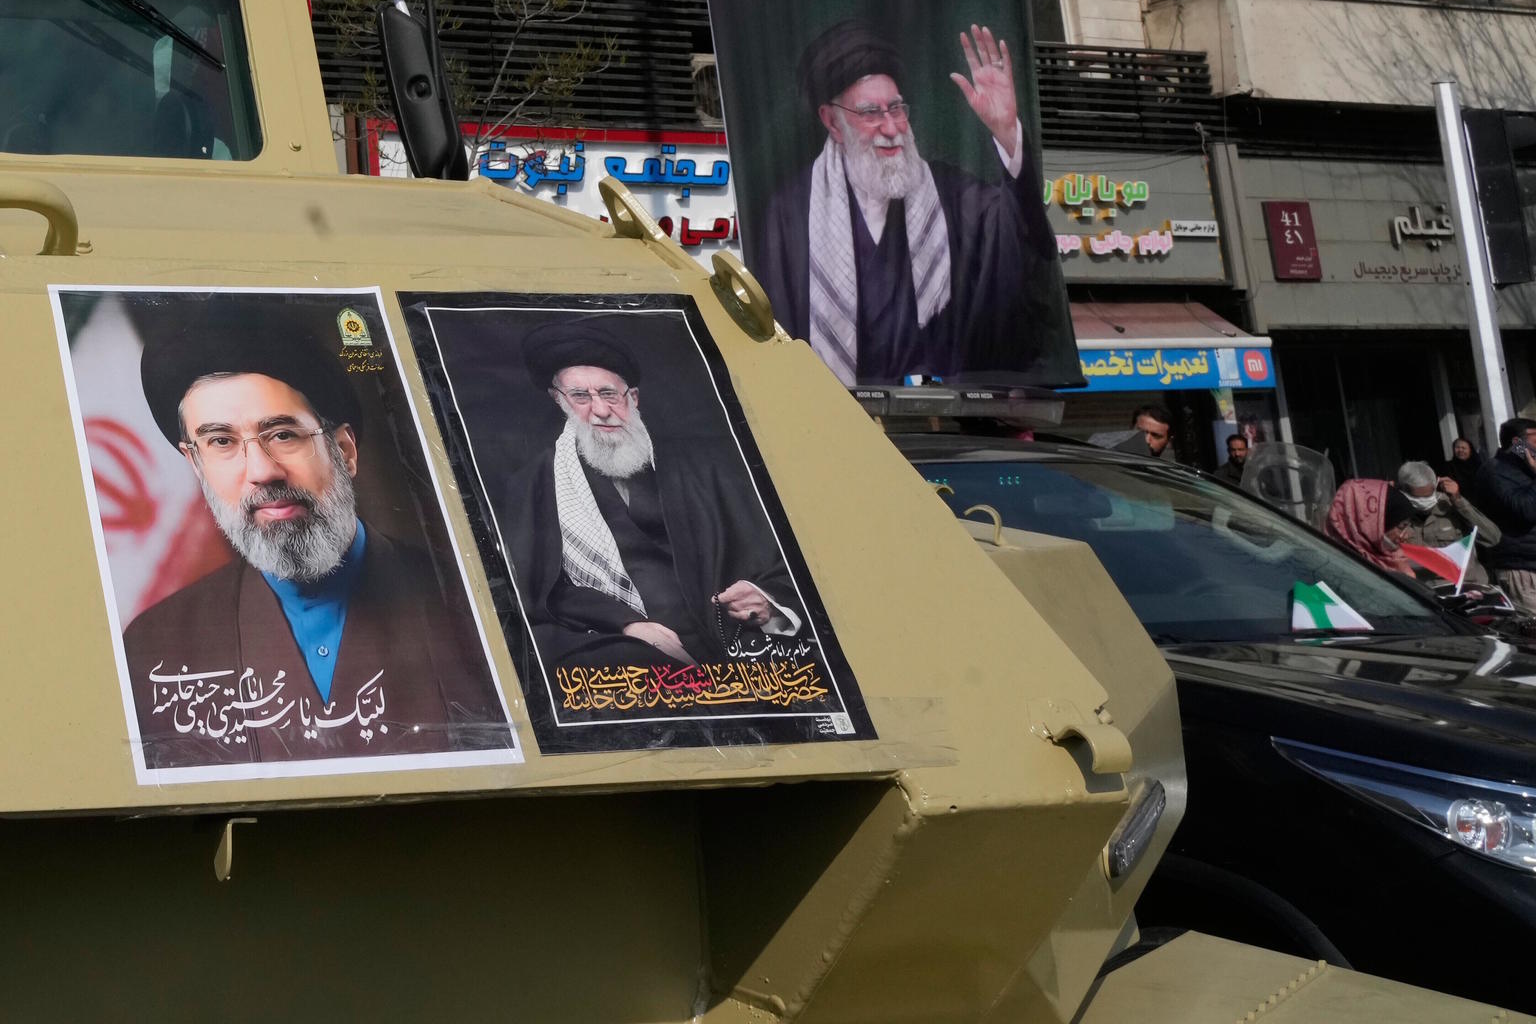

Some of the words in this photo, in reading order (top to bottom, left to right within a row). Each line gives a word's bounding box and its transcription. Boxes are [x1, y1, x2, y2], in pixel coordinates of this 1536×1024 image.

[479, 141, 585, 195] نبوت
[604, 144, 730, 198] مجتمع
[1064, 174, 1150, 218] موبایل
[1280, 210, 1302, 227] 41
[1393, 204, 1456, 247] فیلم
[1090, 230, 1134, 255] جانبی
[1138, 230, 1174, 256] لوازم
[1285, 229, 1304, 245] ٤١
[1400, 265, 1429, 283] سریع
[1430, 263, 1451, 282] چاپ
[1079, 350, 1134, 376] تخص
[1137, 350, 1209, 385] تعمیرات
[727, 635, 773, 662] شهیدان
[770, 642, 785, 663] امام
[786, 649, 794, 661] بر
[793, 639, 811, 668] سلام
[238, 667, 263, 717] امام
[646, 664, 713, 694] شهید
[780, 662, 828, 706] حضرت
[228, 699, 296, 743] سید
[300, 696, 317, 739] یا
[314, 669, 388, 745] لبیک
